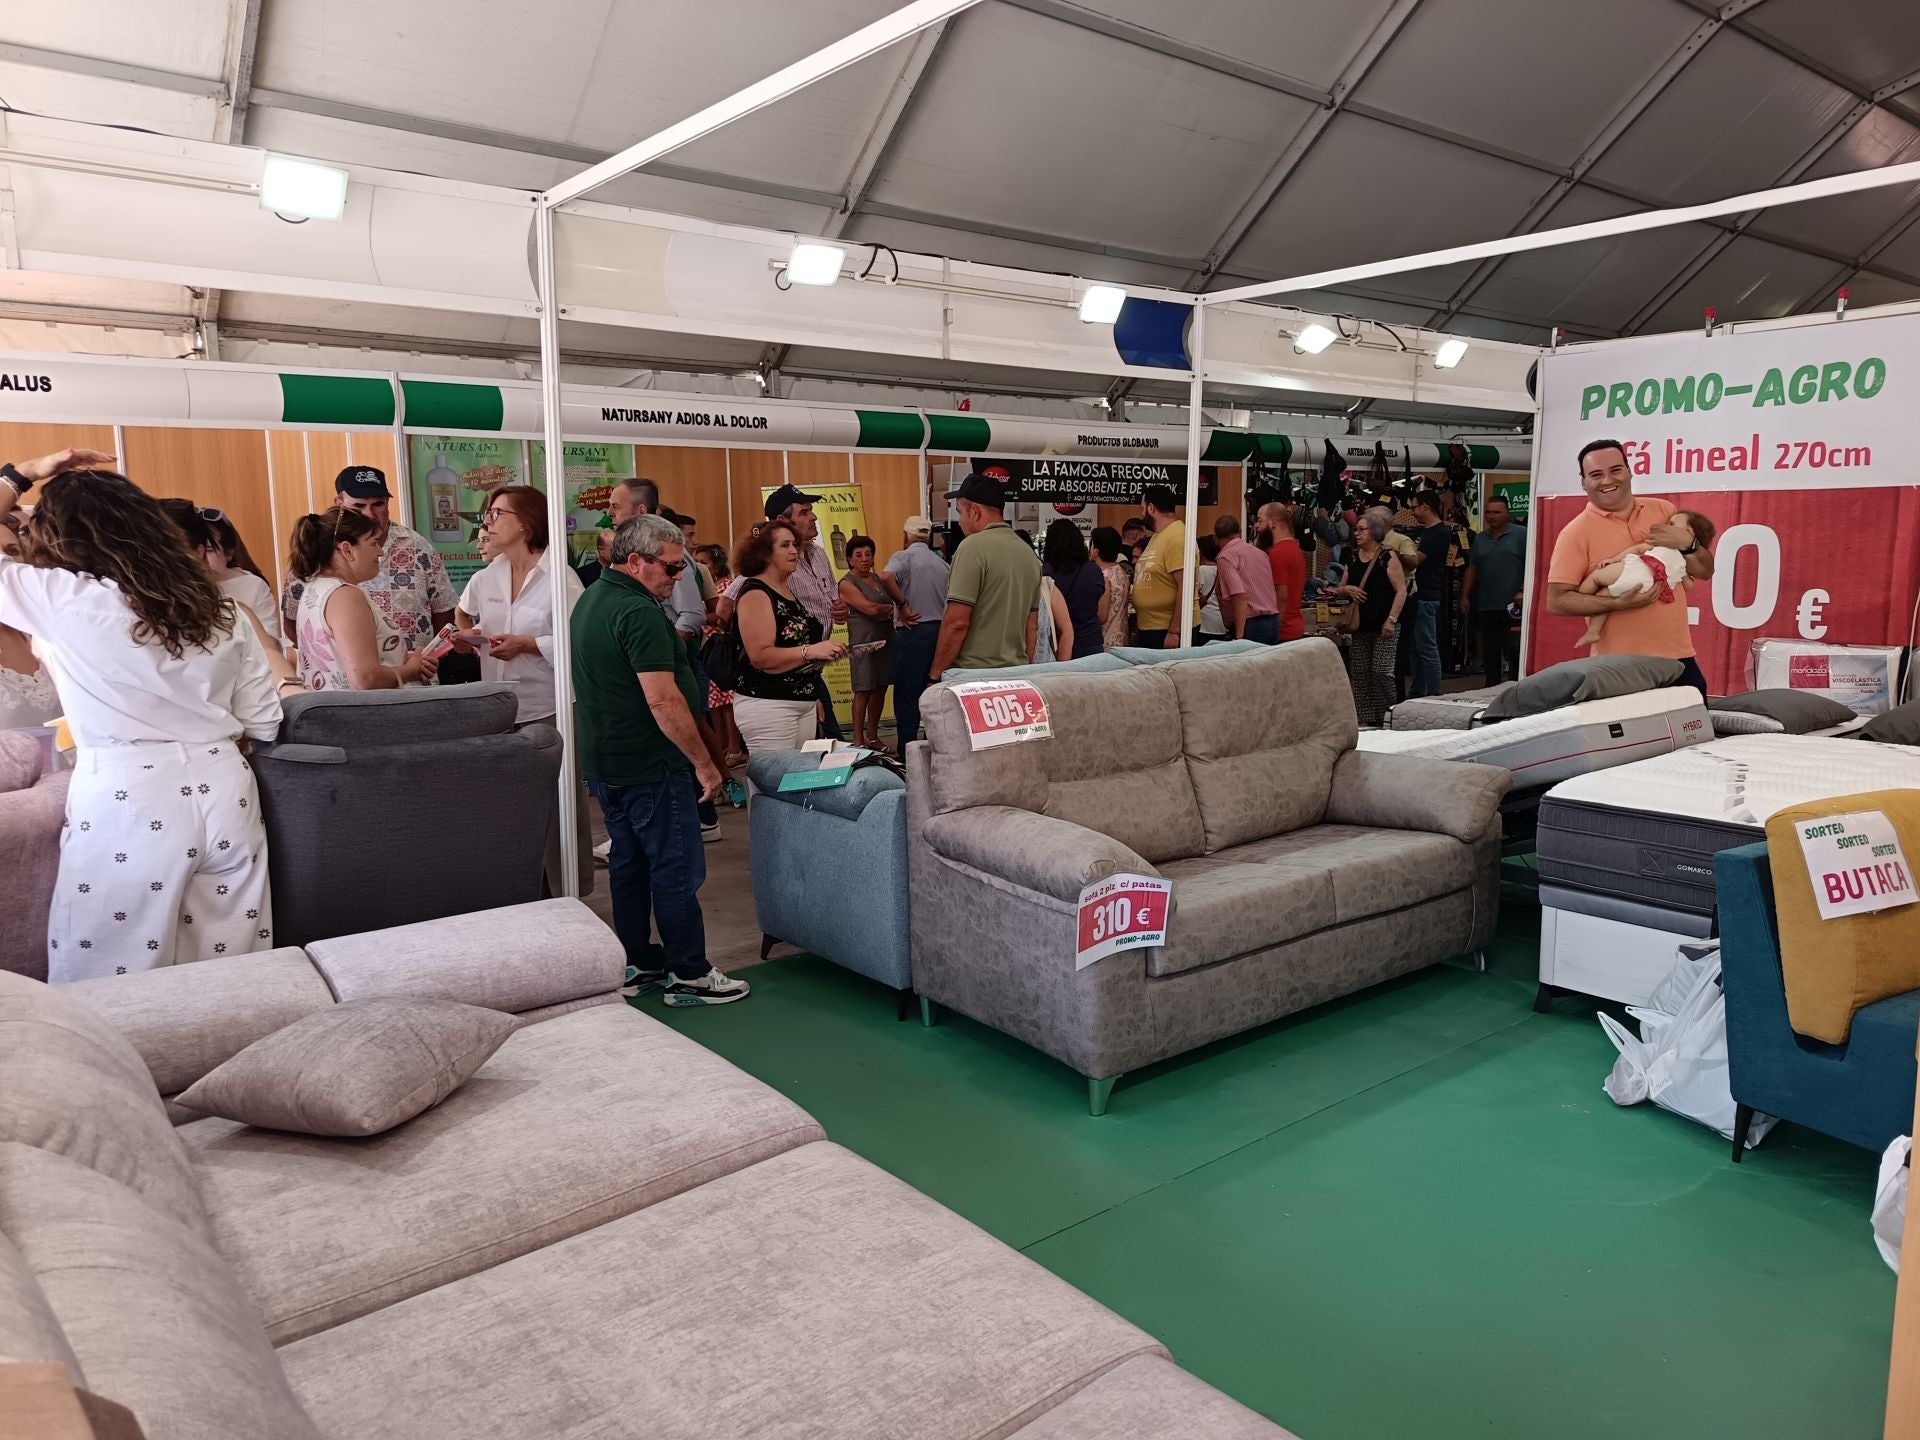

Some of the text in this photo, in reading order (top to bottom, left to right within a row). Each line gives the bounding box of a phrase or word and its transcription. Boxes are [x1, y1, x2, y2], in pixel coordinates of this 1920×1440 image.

[0, 373, 52, 393] ALUS
[1579, 357, 1887, 421] PROMO-AGRO
[601, 407, 768, 429] NATURSANY ADIOS AL DOLOR
[421, 441, 501, 452] NATURSANY
[1077, 434, 1159, 448] PRODUCTOS GLOBASUR
[539, 446, 609, 456] NURSANY
[1664, 433, 1760, 474] lineal
[1773, 441, 1872, 470] 270cm
[1032, 460, 1170, 480] LA FAMOSA FREGONA
[1021, 478, 1057, 492] SUPER
[1058, 480, 1128, 494] ABSORBENTE
[1129, 482, 1143, 494] DE
[1795, 588, 1831, 640] €
[978, 694, 1037, 728] 605 €
[1682, 719, 1703, 733] HYBRID
[1804, 822, 1845, 840] SORTEO
[1836, 833, 1870, 850] SORTEO
[1871, 843, 1897, 857] SORTEO
[1676, 864, 1713, 876] GOMARCO
[1099, 887, 1104, 896] 2
[1120, 879, 1130, 888] c/
[1132, 880, 1162, 889] patas
[1822, 861, 1910, 904] BUTACA
[1092, 897, 1151, 941] 310 €
[1115, 933, 1161, 947] PROMO-AGRO
